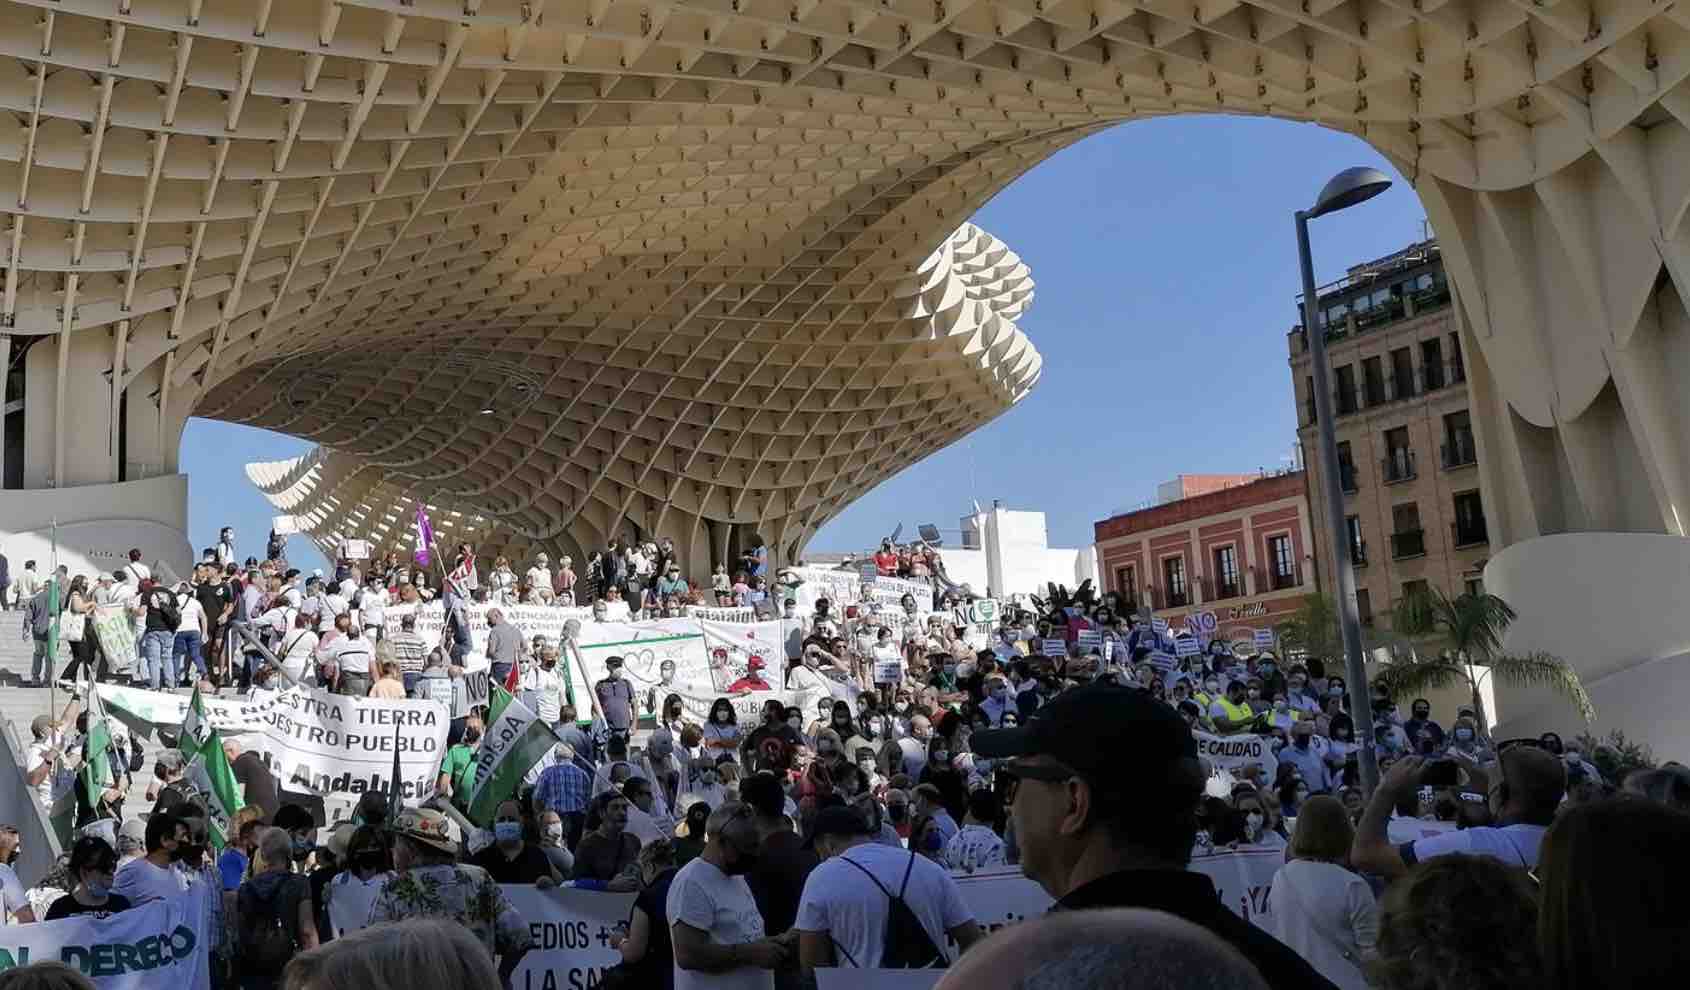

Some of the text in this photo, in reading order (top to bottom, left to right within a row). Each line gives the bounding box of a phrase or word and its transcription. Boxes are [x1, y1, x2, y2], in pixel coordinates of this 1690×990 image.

[1184, 612, 1216, 632] NO
[465, 671, 488, 704] NO
[356, 708, 436, 726] TIERRA
[345, 734, 437, 753] PUEBLO
[1209, 740, 1262, 757] CALIDAD
[529, 921, 589, 950] EDIOS
